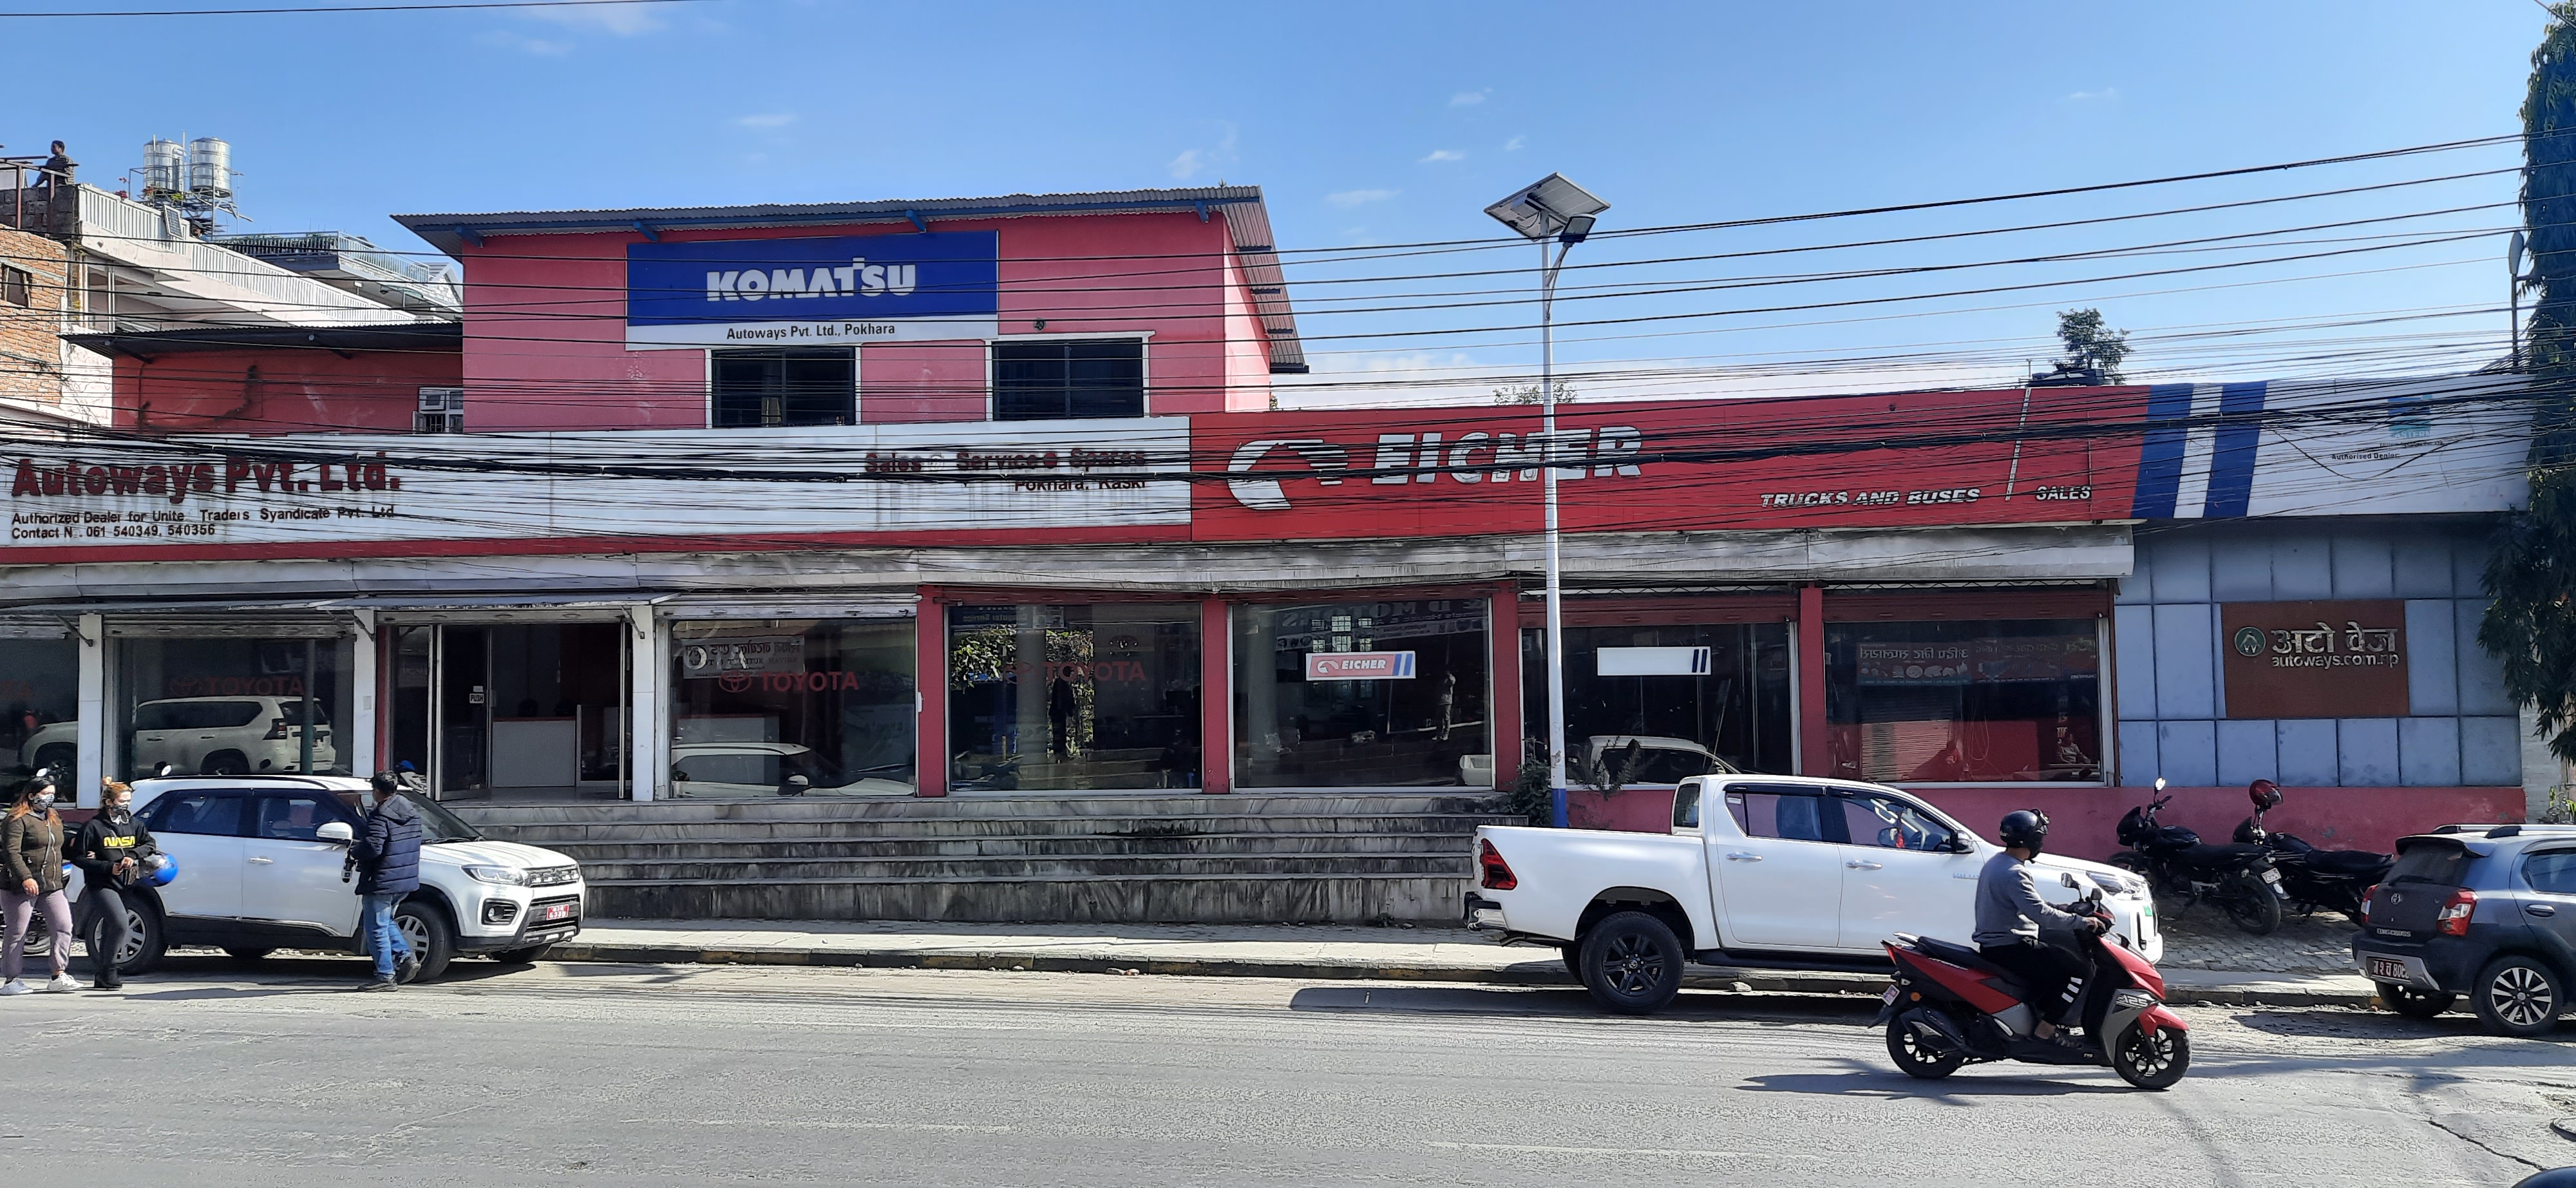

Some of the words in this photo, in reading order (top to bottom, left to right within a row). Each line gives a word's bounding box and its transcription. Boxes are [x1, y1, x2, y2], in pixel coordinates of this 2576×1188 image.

[706, 257, 916, 302] KOMATSU
[727, 328, 786, 340] Autoways
[791, 326, 811, 337] Pvt.
[817, 325, 840, 337] Ltd.,
[845, 323, 895, 335] Pokhara
[1372, 426, 1642, 484] EICHER
[13, 459, 214, 504] Autoways
[226, 455, 308, 492] Pvt.
[320, 452, 400, 491] Ltd.
[1760, 491, 1848, 508] TRUCKS
[1853, 490, 1900, 506] AND
[1906, 488, 1980, 505] BUSES
[2036, 486, 2092, 501] SALES
[12, 513, 80, 526] Authorized
[84, 511, 120, 523] Dealer
[129, 511, 146, 522] for
[260, 508, 330, 522] Syandicate
[12, 526, 59, 540] Contact
[86, 526, 106, 538] 061
[168, 524, 215, 537] 540356
[2271, 622, 2336, 653] अटो
[2345, 621, 2398, 653] वेज
[1041, 661, 1146, 682] TOYOTA
[1341, 659, 1387, 669] EICHER
[2271, 654, 2400, 669] autoways.com.np
[207, 675, 306, 696] TOYOTA
[757, 671, 859, 692] TOYOTA
[104, 836, 135, 847] NASA
